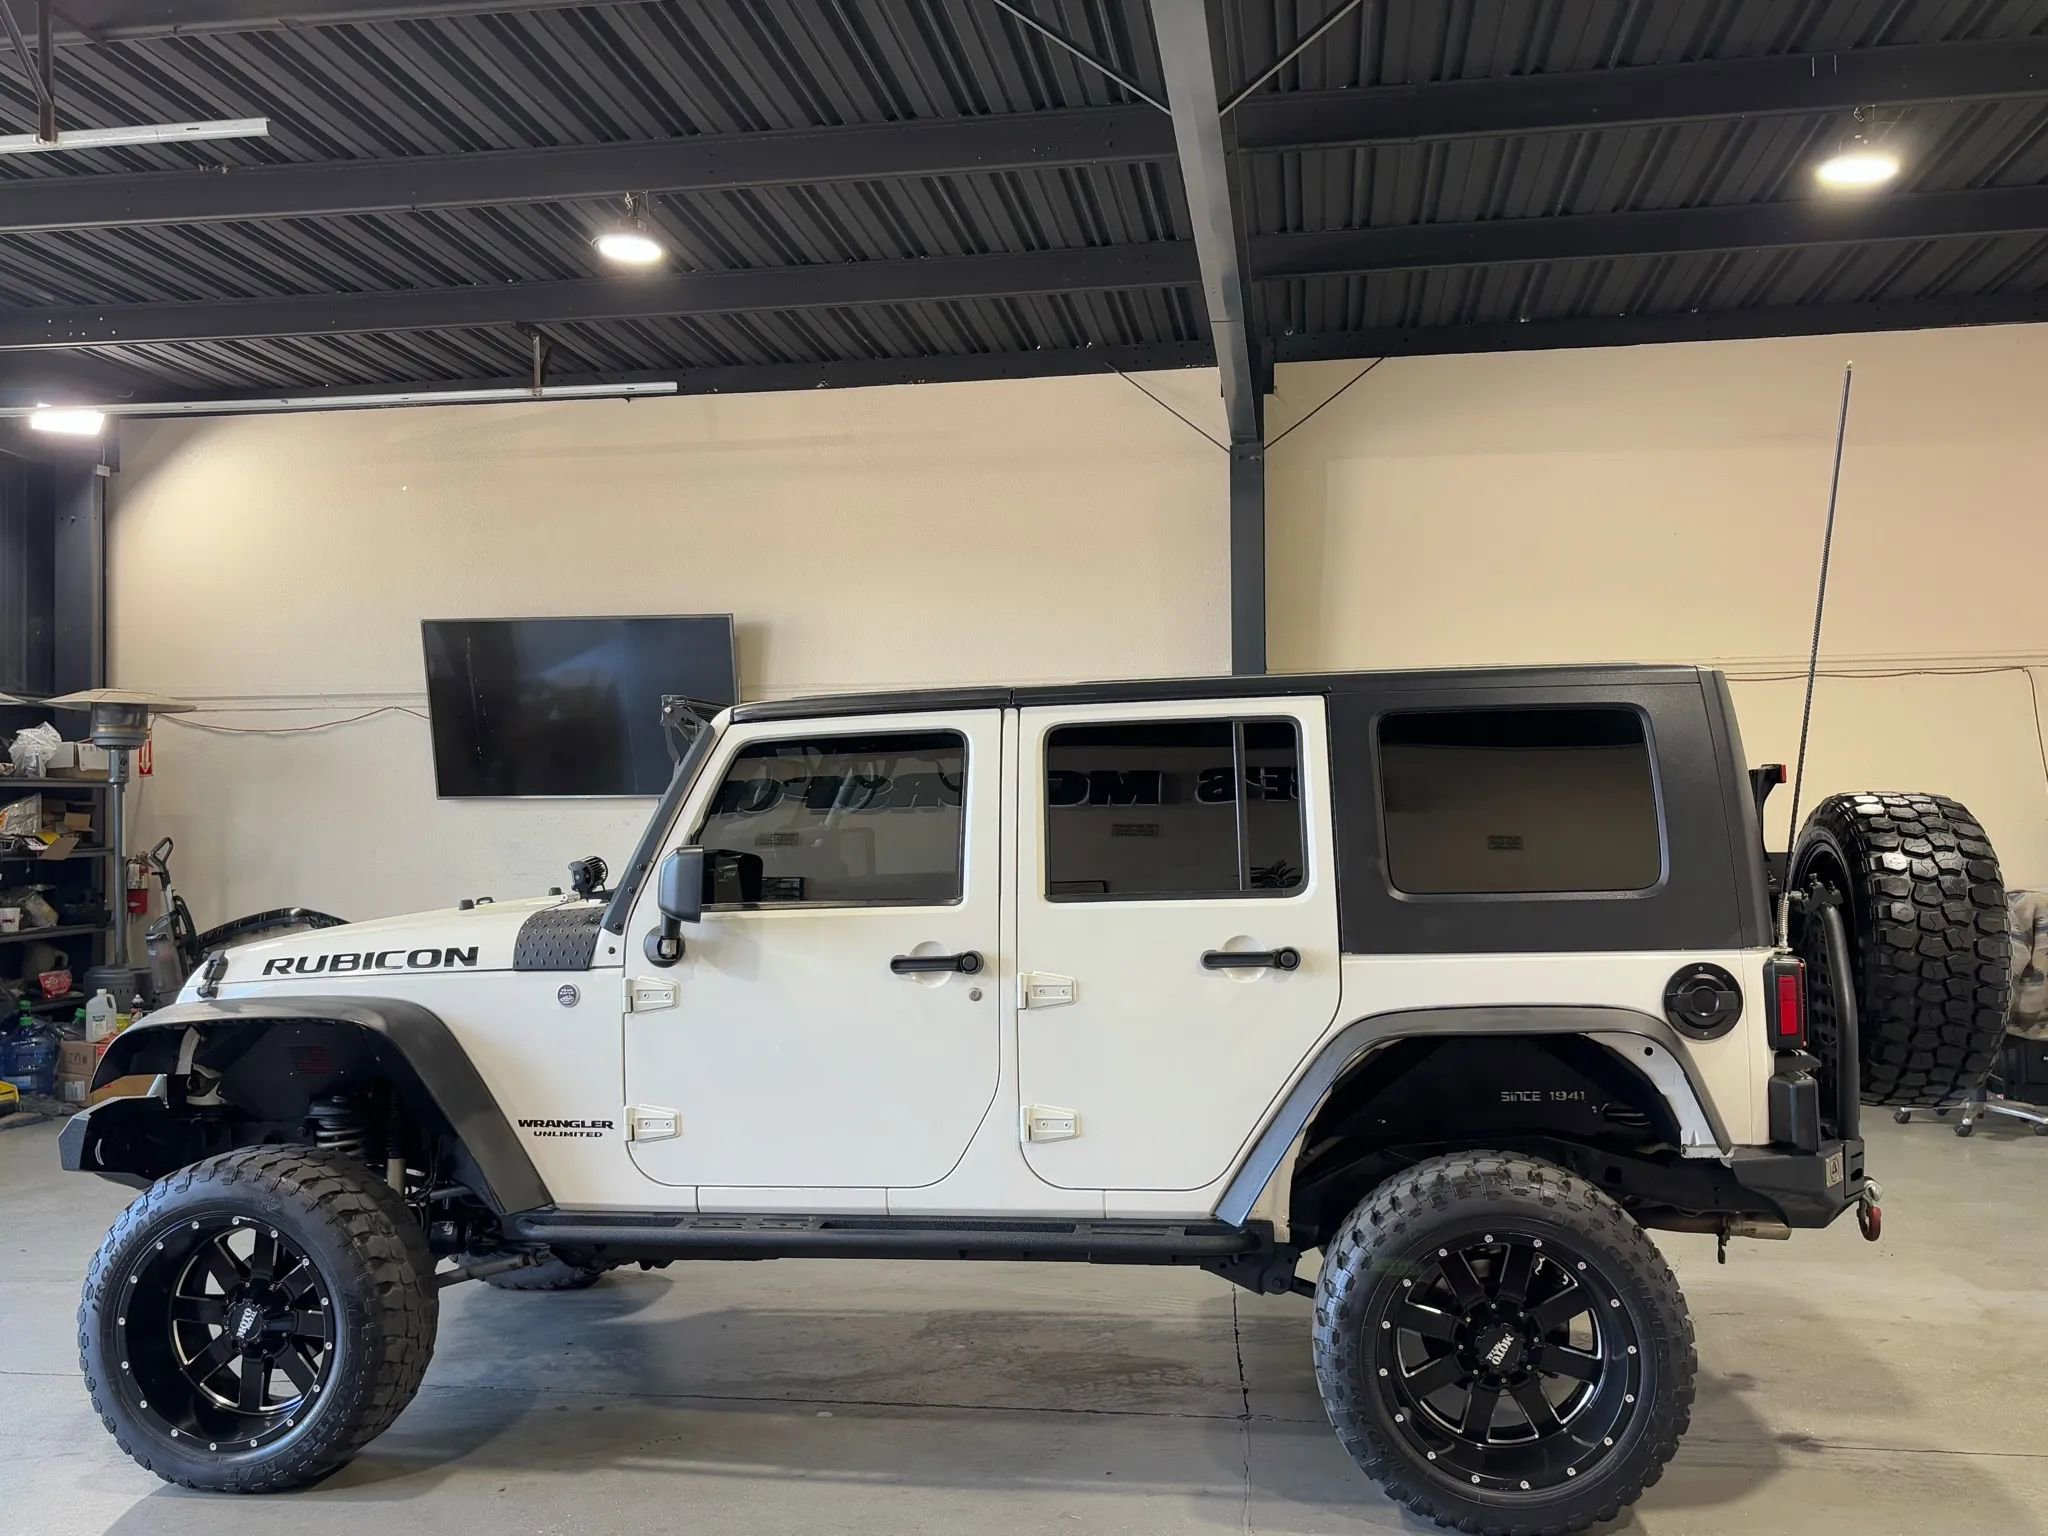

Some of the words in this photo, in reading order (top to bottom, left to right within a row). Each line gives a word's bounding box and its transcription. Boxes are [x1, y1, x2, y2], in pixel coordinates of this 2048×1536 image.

[262, 946, 479, 975] RUBICON
[1500, 1091, 1542, 1102] SINCE
[1549, 1090, 1585, 1101] 1941
[518, 1119, 614, 1130] WRANGLER
[236, 1307, 252, 1339] MOTO
[1491, 1333, 1515, 1365] MOTO
